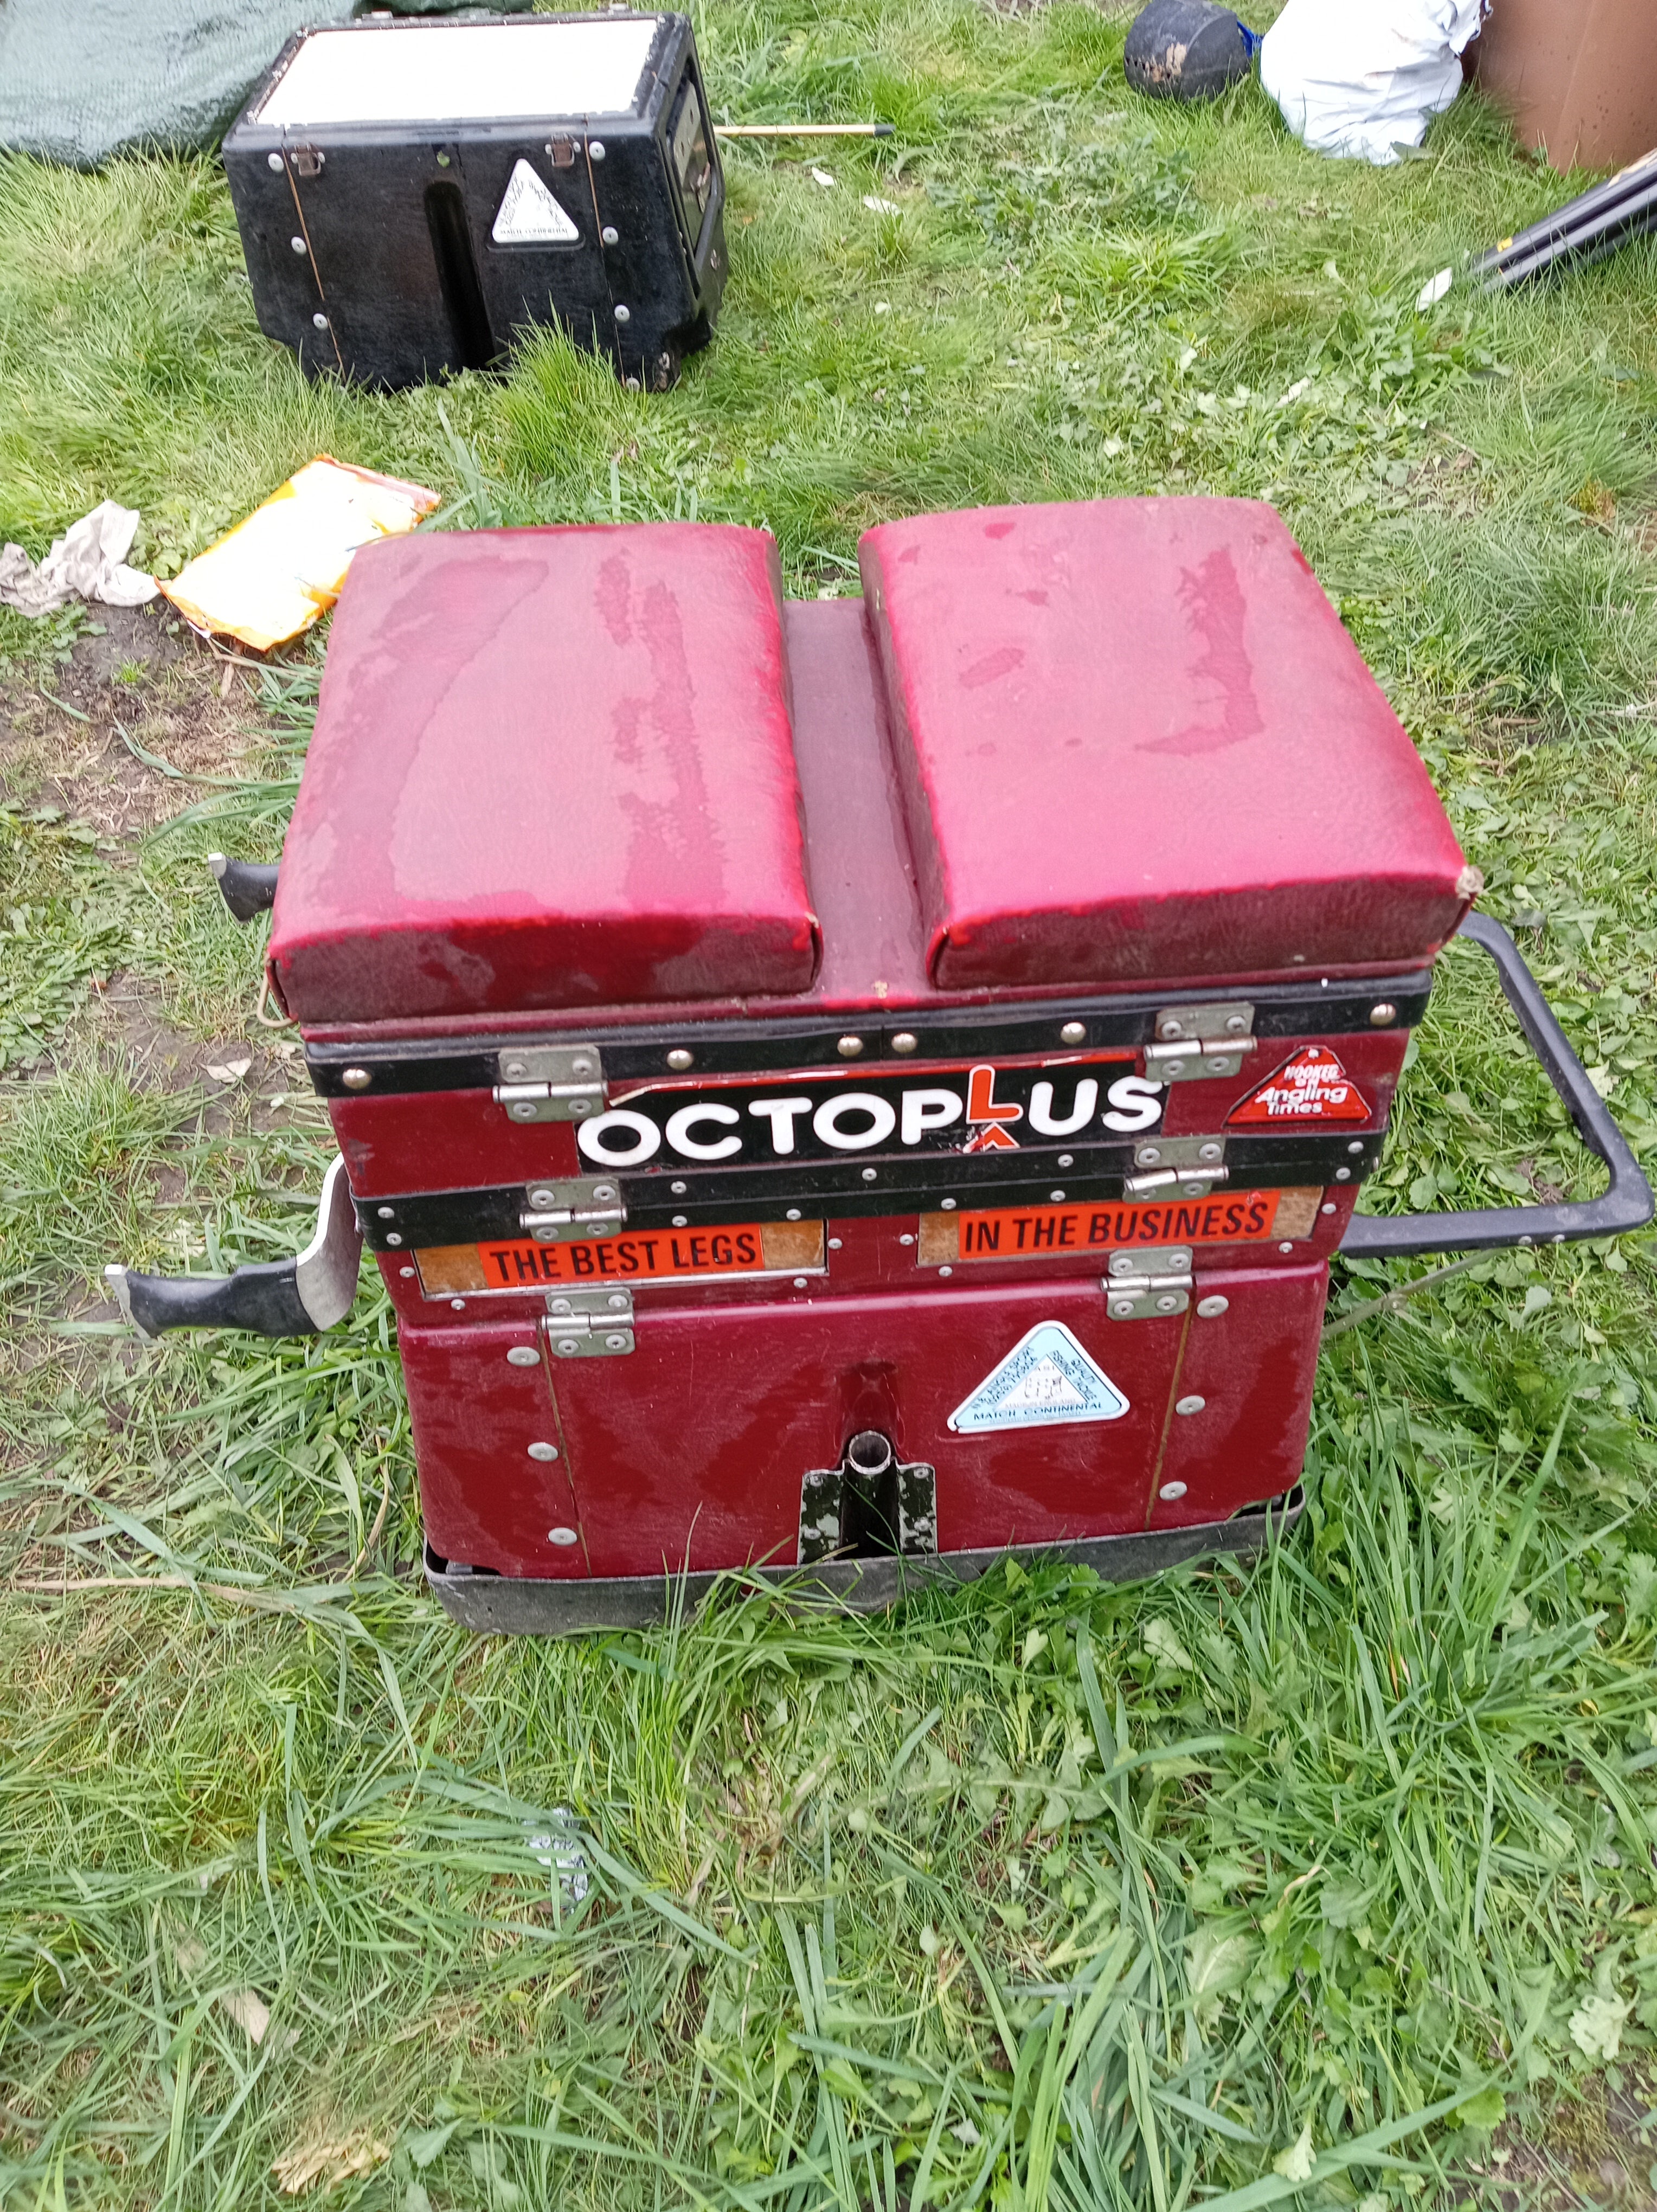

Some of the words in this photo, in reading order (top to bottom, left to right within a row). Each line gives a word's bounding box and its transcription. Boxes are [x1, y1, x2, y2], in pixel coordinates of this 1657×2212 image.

[1254, 1086, 1348, 1104] Angling
[1267, 1102, 1322, 1116] Times
[577, 1064, 1164, 1167] OCTOPLUS
[965, 1221, 1000, 1252] IN
[1012, 1214, 1079, 1249] THE
[1088, 1202, 1269, 1244] BUSINESS
[489, 1248, 563, 1282] THE
[571, 1240, 659, 1276] BEST
[671, 1233, 757, 1269] LEGS
[974, 1409, 1016, 1420] MATCH
[1024, 1401, 1102, 1415] CONTINENTAL
